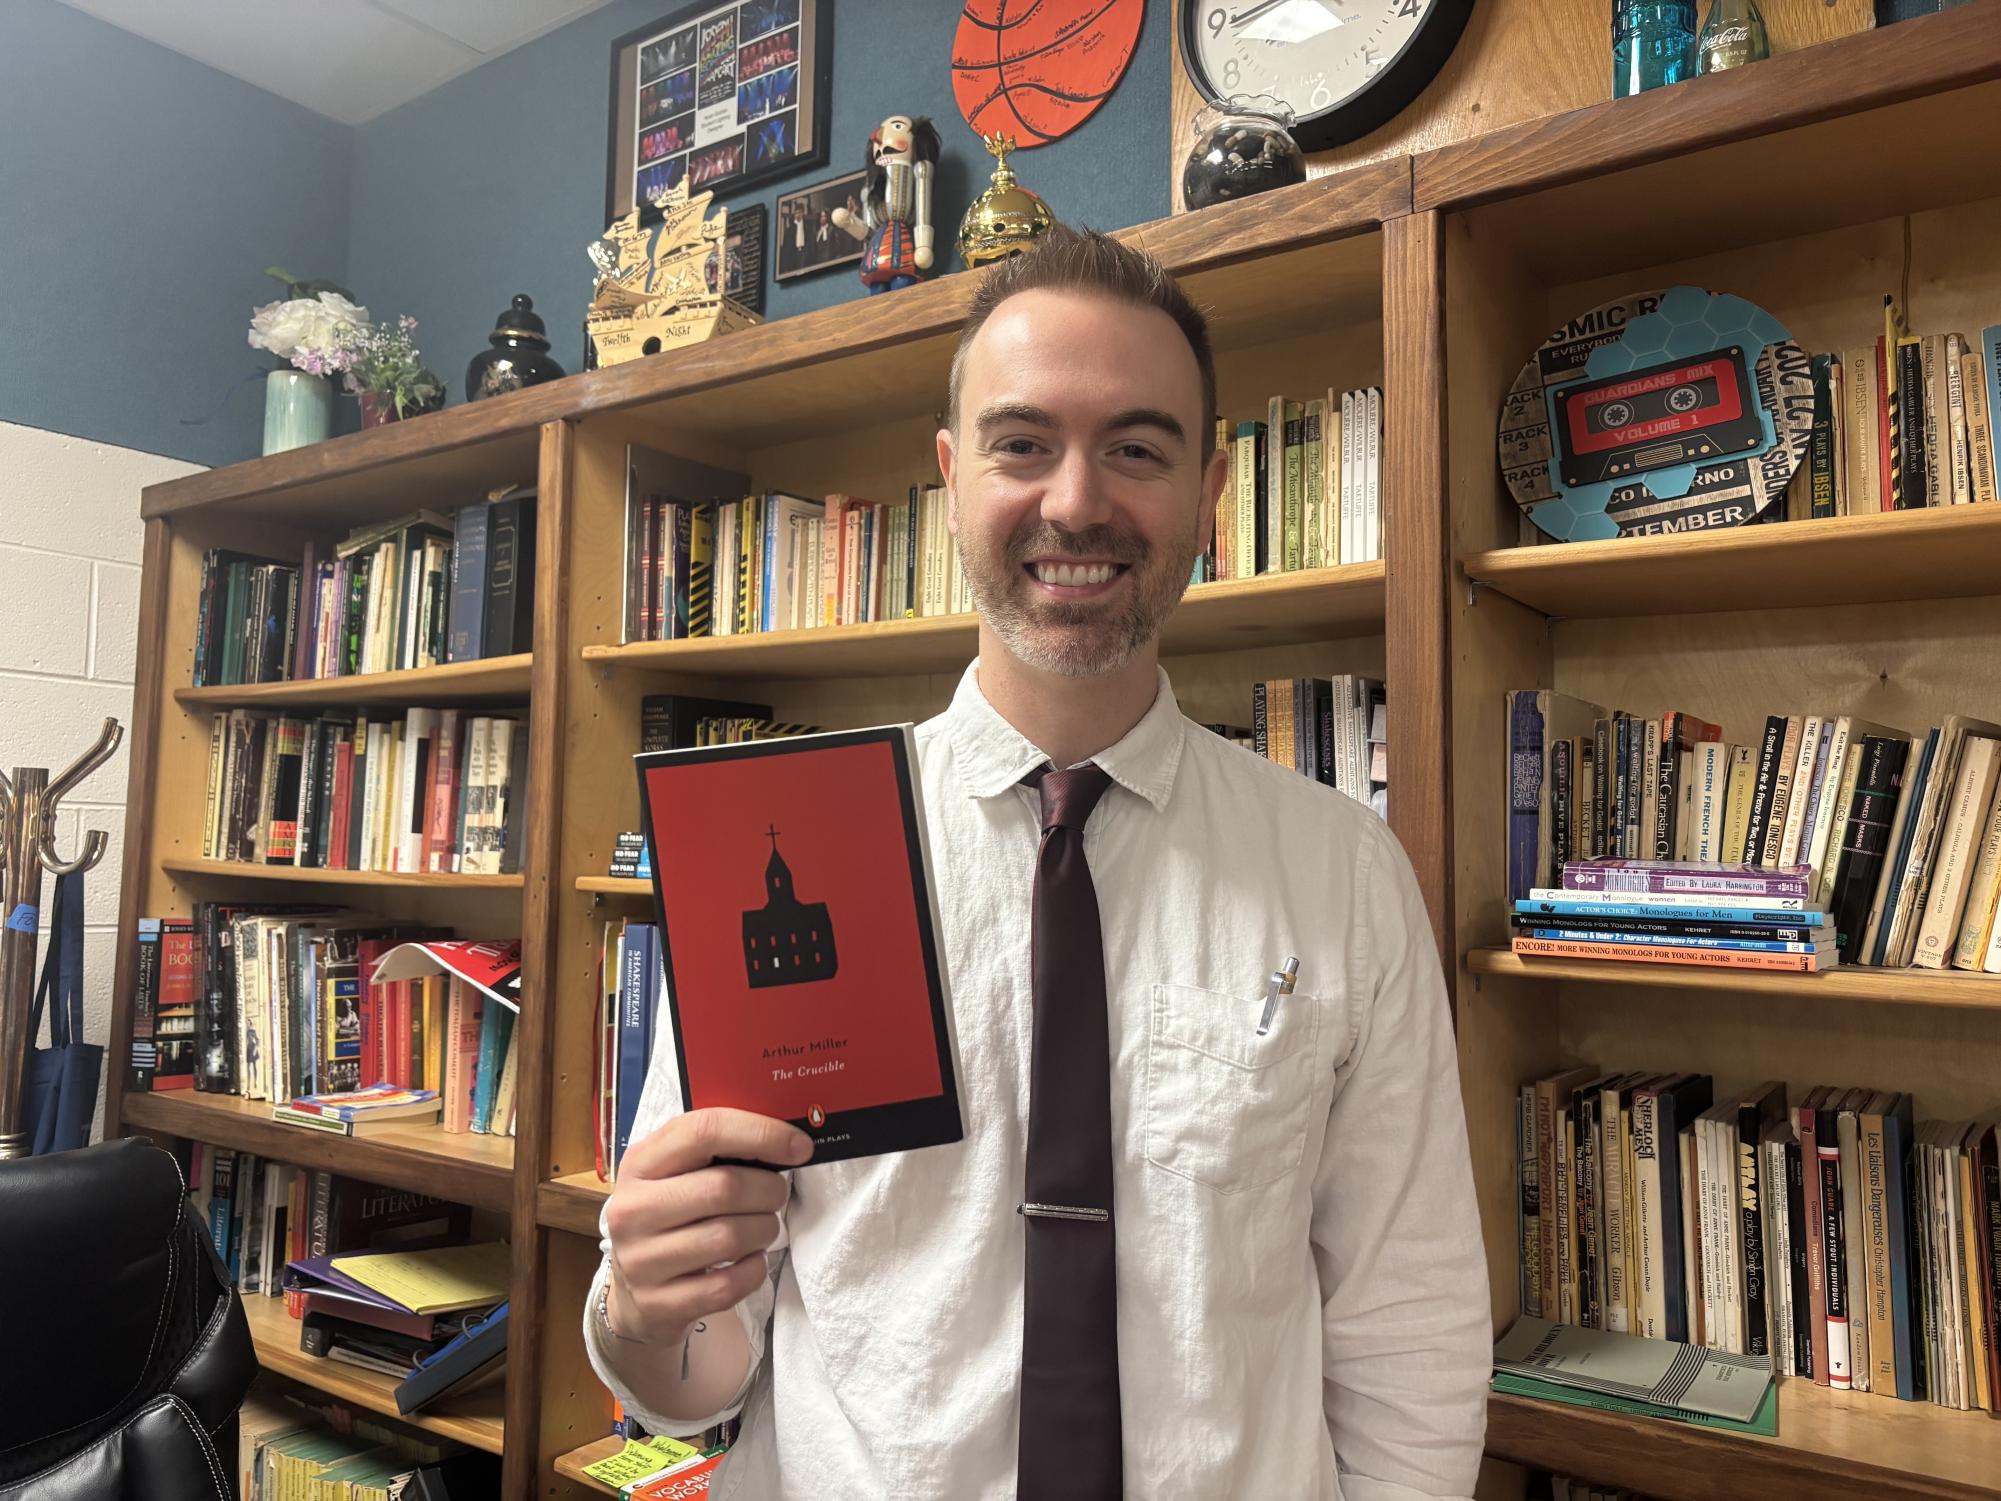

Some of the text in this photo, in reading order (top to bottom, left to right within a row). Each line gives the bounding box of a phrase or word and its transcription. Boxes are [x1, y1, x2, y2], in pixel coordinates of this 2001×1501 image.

[1207, 8, 1226, 39] 9
[1223, 58, 1240, 89] 8
[1310, 79, 1331, 111] 6
[603, 326, 691, 346] Twelfth Night
[1585, 364, 1714, 403] GUARDIANS MIX
[1505, 390, 1541, 406] ACK
[1514, 407, 1524, 416] 2
[1614, 414, 1698, 442] VOLUME 1
[1975, 424, 1985, 443] THREE
[1519, 442, 1528, 450] 3
[1816, 433, 1826, 455] PLAYS
[1289, 455, 1299, 470] The
[1816, 459, 1826, 468] BY
[1524, 480, 1535, 490] 4
[1815, 472, 1829, 505] IBSEN
[1287, 471, 1298, 527] Misanthrope
[1256, 687, 1265, 729] PLAYING
[1647, 725, 1655, 755] KRAPP'S
[1765, 735, 1776, 753] Stroll
[1802, 722, 1816, 767] THE KILLER
[1762, 761, 1771, 771] the
[1832, 756, 1840, 770] King
[1760, 773, 1768, 783] Air
[1777, 775, 1789, 785] BY
[1658, 759, 1673, 838] The Caucasian
[1702, 749, 1715, 840] MODERN FRENCH
[1754, 793, 1765, 814] Frenzy
[1582, 801, 1590, 840] BECKET
[1753, 816, 1762, 825] for
[1855, 796, 1871, 848] NAKED MASKS
[1766, 825, 1781, 859] IONESCO
[1666, 878, 1764, 891] EDITED BY LAURA HARRINGTON
[1546, 891, 1598, 901] Contemporary
[1602, 894, 1643, 902] Monologue
[1639, 907, 1692, 919] Monologues
[1696, 909, 1708, 918] for
[1712, 910, 1732, 918] Men
[1516, 942, 1554, 951] ENCORE!
[1579, 946, 1609, 954] WINNING
[1612, 948, 1652, 957] MONOLOGS
[1672, 952, 1697, 960] YOUNG
[1701, 953, 1730, 962] ACTORS
[631, 950, 641, 1028] SHAKESPEARE
[762, 1038, 848, 1058] Arthur Miller
[772, 1060, 845, 1080] The Crucible
[827, 1133, 850, 1142] PLAYS
[1576, 1160, 1584, 1185] Balcony
[1607, 1118, 1622, 1301] THE WORKER Gibson
[1829, 1222, 1837, 1237] FEW
[1868, 1132, 1887, 1320] Les Liaisons Dangereuses Christopher Hampton
[1830, 1240, 1838, 1262] STOUT
[1812, 1242, 1821, 1290] Trevor Griffiths
[1830, 1264, 1840, 1310] INDIVIDUALS
